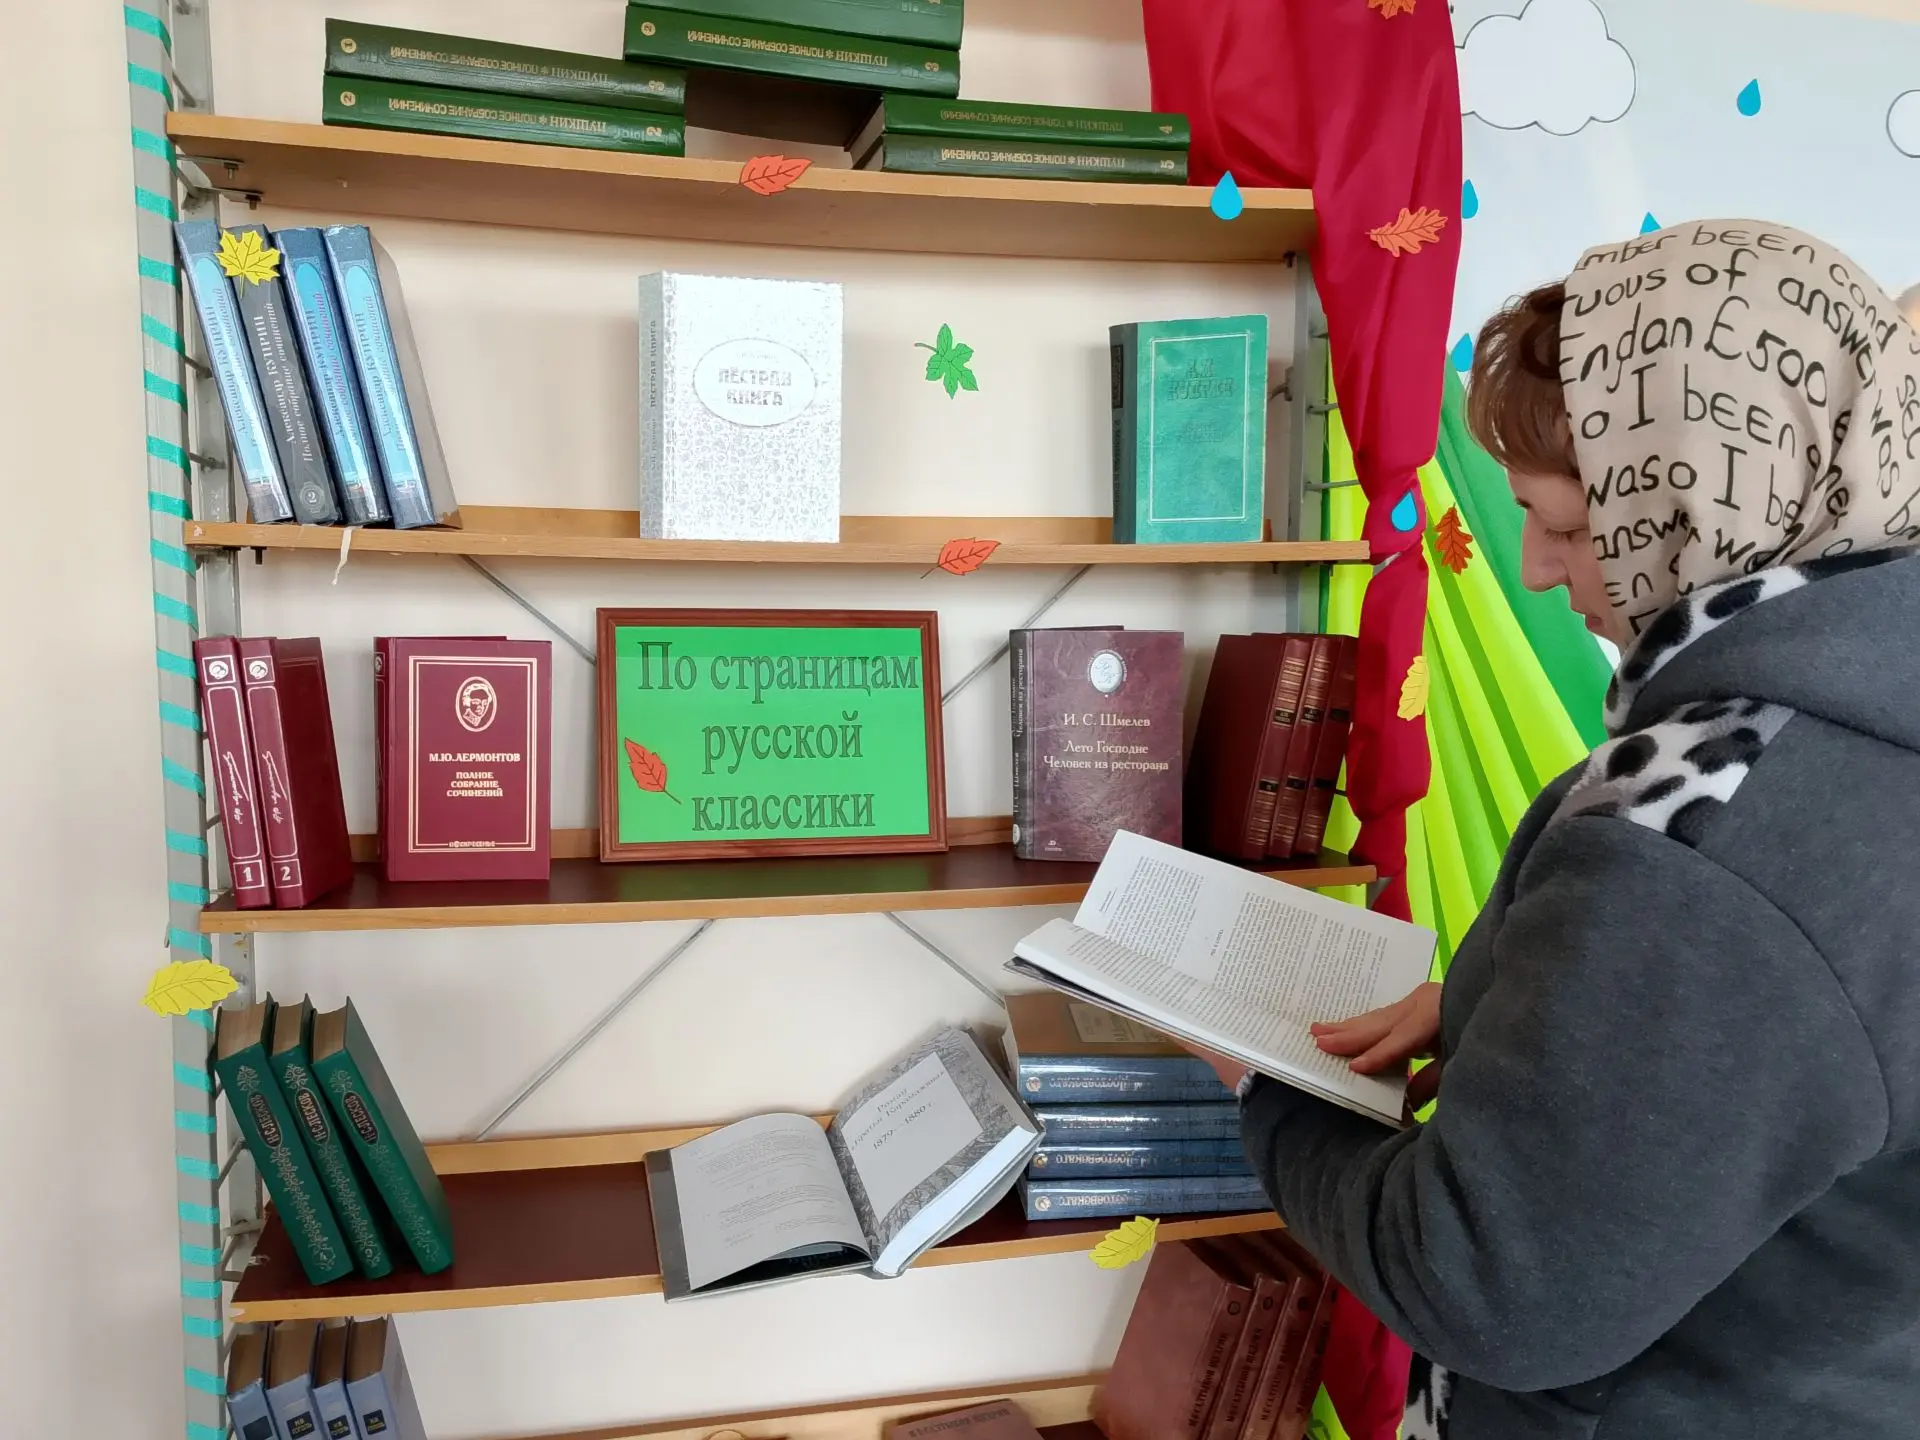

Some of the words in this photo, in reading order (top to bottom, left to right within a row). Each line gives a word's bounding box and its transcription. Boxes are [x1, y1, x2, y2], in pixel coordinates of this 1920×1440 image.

[687, 30, 741, 48] СОЧИНЕНИЙ
[741, 38, 788, 54] СОБРАНИЕ
[390, 46, 450, 64] СОЧИНЕНИЙ
[788, 44, 824, 58] ПОЛНОЕ
[835, 51, 888, 67] ПУШКИН
[450, 54, 499, 69] СОБРАНИЕ
[499, 60, 539, 75] ПОЛНОЕ
[551, 66, 608, 83] ПУШКИН
[388, 98, 447, 115] СОЧИНЕНИЙ
[448, 104, 497, 120] СОБРАНИЕ
[498, 111, 537, 125] ПОЛНОЕ
[549, 116, 607, 133] ПУШКИН
[940, 110, 988, 123] СОЧИНЕНИЙ
[989, 113, 1032, 126] СОБРАНИЕ
[1032, 116, 1064, 128] ПОЛНОЕ
[941, 148, 991, 163] СОЧИНЕНИЙ
[991, 150, 1033, 164] СОБРАНИЕ
[1033, 152, 1066, 165] ПОЛНОЕ
[1077, 155, 1125, 169] ПУШКИН
[1685, 248, 1759, 292] of
[266, 303, 288, 363] сочинений
[305, 310, 328, 371] КУПРИН
[253, 314, 278, 375] КУПРИН
[355, 312, 380, 373] КУПРИН
[280, 363, 302, 418] собрание
[272, 374, 296, 444] Александр
[322, 370, 345, 438] Александр
[295, 417, 313, 463] Полное
[307, 491, 317, 503] 2
[638, 641, 697, 690] По
[711, 655, 919, 704] страницам
[1064, 714, 1079, 726] И.
[1082, 713, 1097, 726] С.
[1100, 714, 1151, 727] Шмелев
[702, 710, 863, 774] русской
[1064, 740, 1093, 753] Лето
[1097, 740, 1149, 754] Господне
[1044, 755, 1091, 769] Человек
[1094, 761, 1108, 769] из
[1111, 761, 1169, 773] ресторана
[446, 788, 503, 797] СОЧИНЕНИЙ
[692, 794, 876, 831] классики
[243, 866, 252, 882] 1
[281, 866, 291, 882] 2
